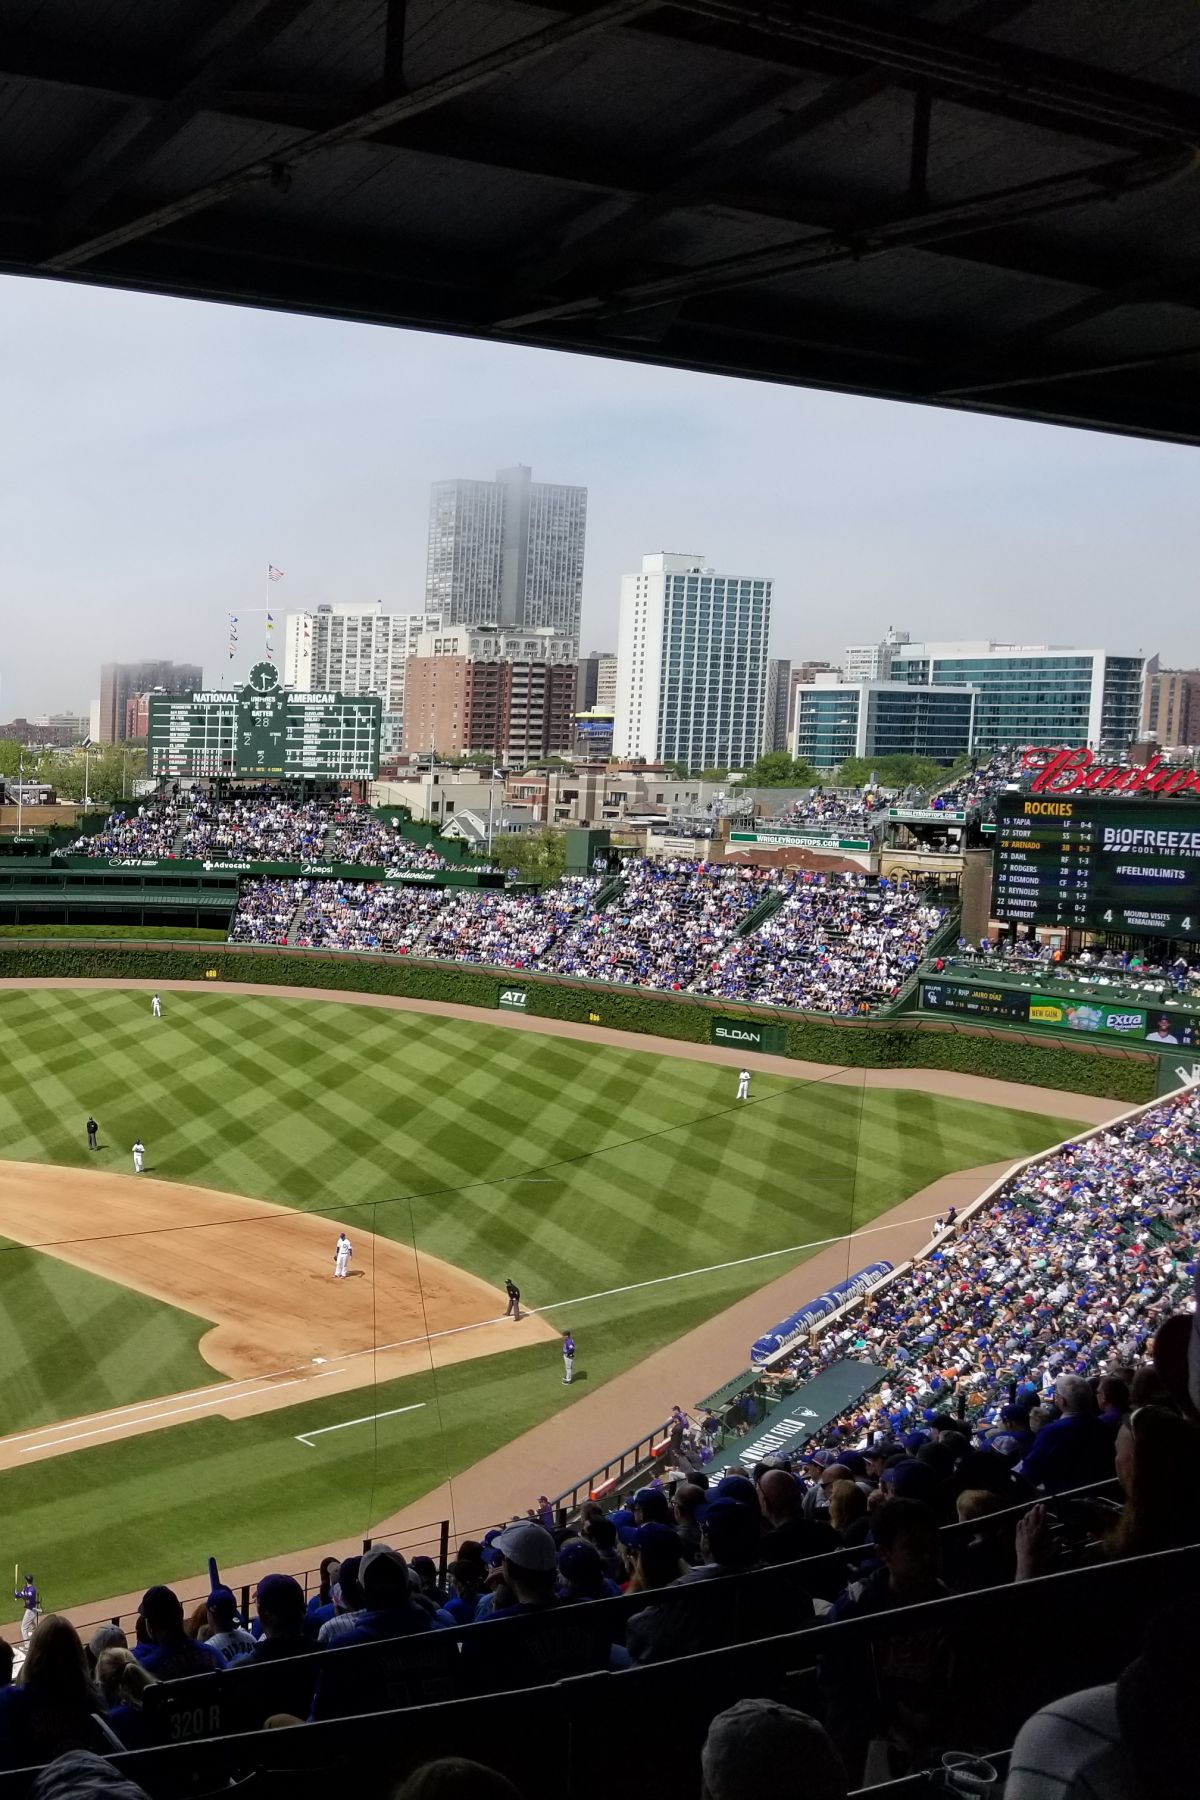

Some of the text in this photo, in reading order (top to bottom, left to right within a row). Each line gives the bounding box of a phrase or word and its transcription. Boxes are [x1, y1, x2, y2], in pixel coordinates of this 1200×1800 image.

[192, 693, 239, 703] NATIONAL
[287, 694, 335, 703] AMERICAN
[255, 718, 269, 727] 28
[244, 736, 251, 745] 2
[257, 754, 264, 764] 2
[1024, 802, 1073, 816] ROCKIES
[1132, 846, 1155, 854] COOL
[1159, 848, 1176, 856] THE
[214, 861, 250, 870] Advocate
[311, 865, 333, 874] pepsi
[1010, 865, 1037, 873] RODGERS
[384, 867, 436, 880] Budweiser
[1009, 876, 1039, 884] DESMOND
[1008, 887, 1039, 896] REYNOLDS
[1008, 898, 1037, 908] IANNETTA
[1007, 910, 1035, 919] LAMBERT
[1104, 909, 1112, 922] 4
[1123, 910, 1170, 920] MOUND VISITS
[1128, 918, 1166, 927] REMAINING
[1181, 916, 1191, 931] 4
[501, 991, 526, 1003] ATI
[1031, 1009, 1047, 1018] NEW
[1106, 1014, 1141, 1027] Extra
[715, 1027, 761, 1042] SLOAN
[833, 1280, 866, 1306] Reynolds
[770, 1418, 806, 1438] FIELD
[170, 1704, 221, 1740] 320 R
